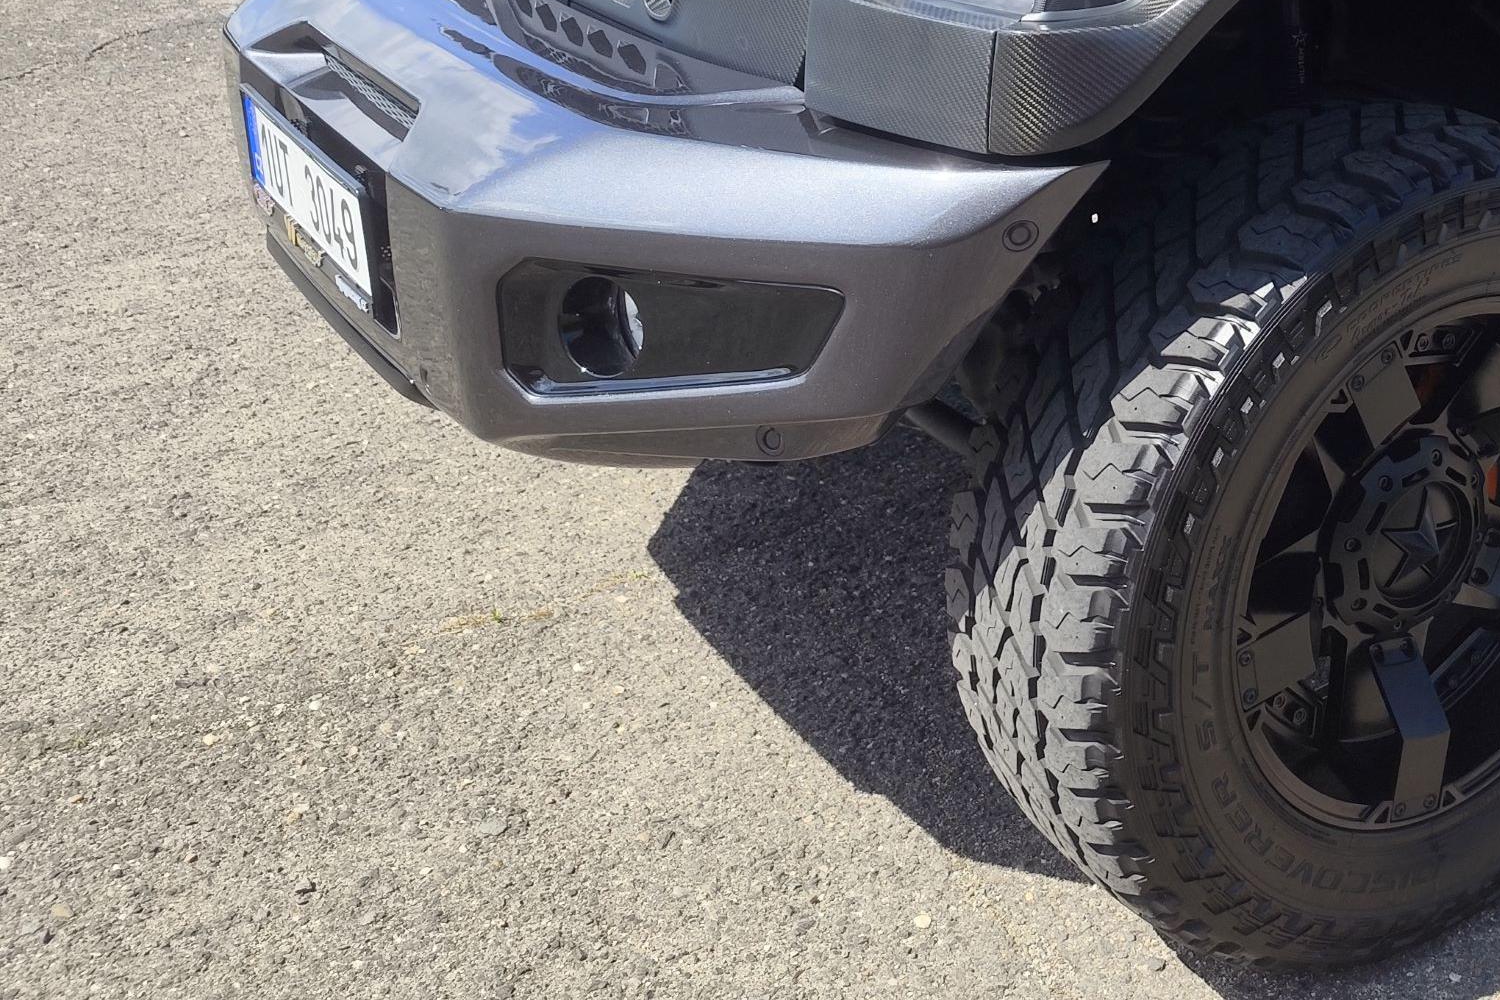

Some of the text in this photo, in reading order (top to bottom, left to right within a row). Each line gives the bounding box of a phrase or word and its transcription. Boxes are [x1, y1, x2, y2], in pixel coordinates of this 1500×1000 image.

[261, 124, 294, 208] 1UT
[305, 165, 359, 271] 3049
[1210, 769, 1440, 895] DISCOVERER
